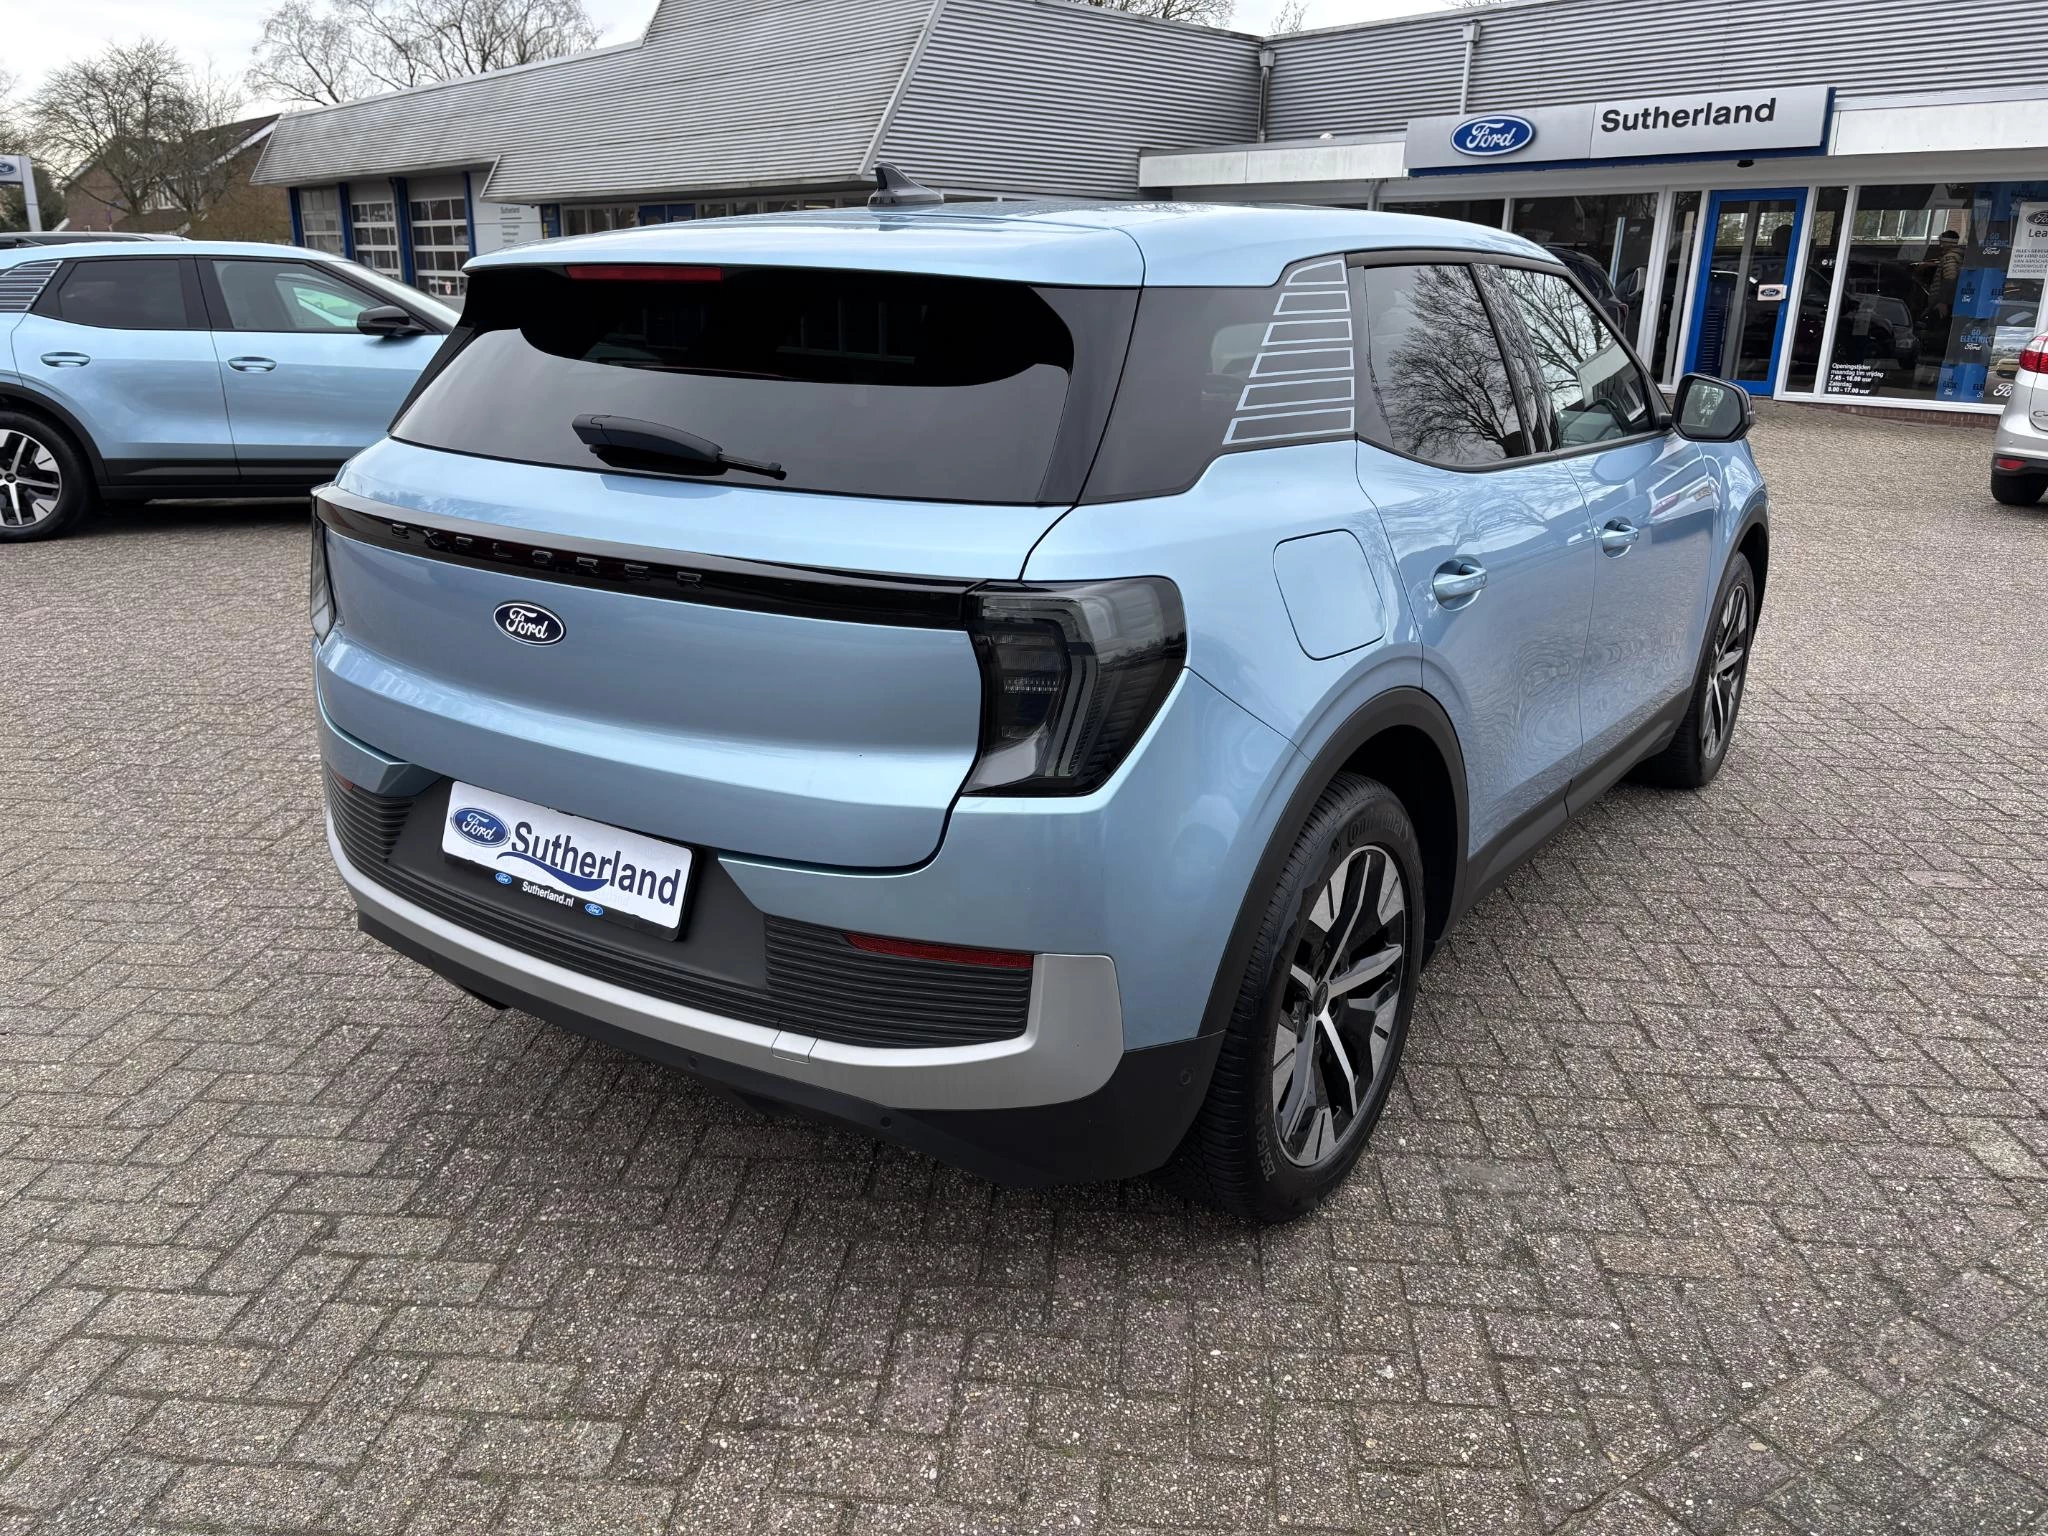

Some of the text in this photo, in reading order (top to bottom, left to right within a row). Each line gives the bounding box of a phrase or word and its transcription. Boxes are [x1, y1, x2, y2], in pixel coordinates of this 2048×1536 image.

[1601, 97, 1777, 133] Sutherland
[1466, 122, 1516, 149] Ford
[2028, 228, 2048, 238] Lea
[1982, 247, 2001, 255] Ford
[1964, 343, 1982, 351] Ford
[1993, 382, 2013, 397] Fo
[391, 523, 704, 589] EXPLORER
[506, 606, 549, 639] Ford
[462, 812, 497, 841] Ford
[511, 821, 681, 907] Sutherland
[521, 881, 575, 907] Sutherland.nl
